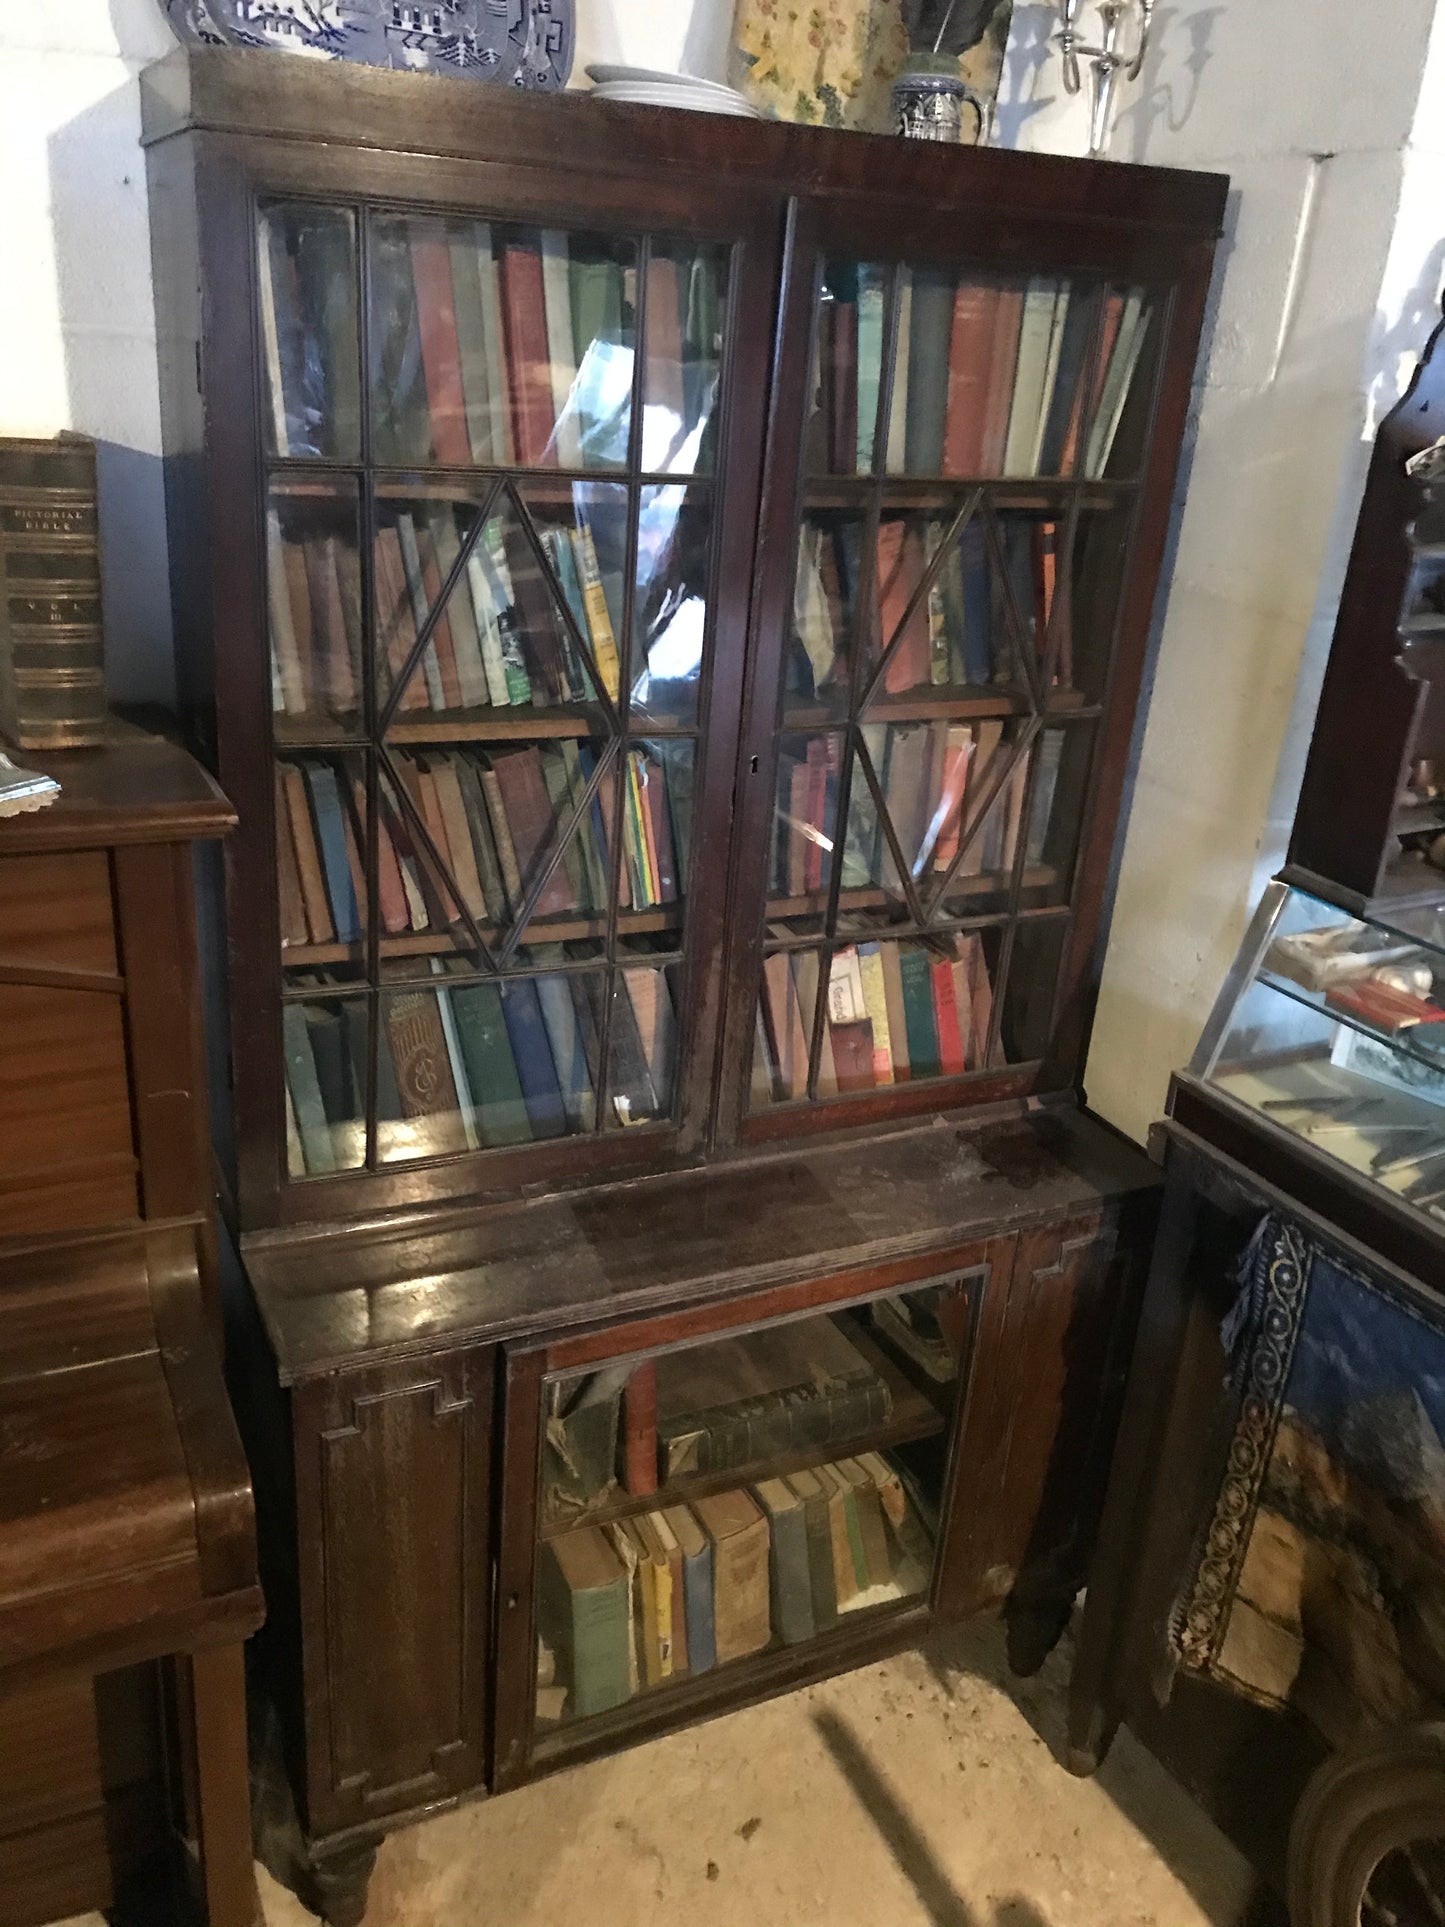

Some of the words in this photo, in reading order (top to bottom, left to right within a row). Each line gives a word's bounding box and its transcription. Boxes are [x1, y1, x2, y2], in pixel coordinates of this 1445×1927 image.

[14, 510, 83, 519] PICTORIAL
[25, 520, 71, 531] BIBLE
[833, 986, 847, 1020] Grand
